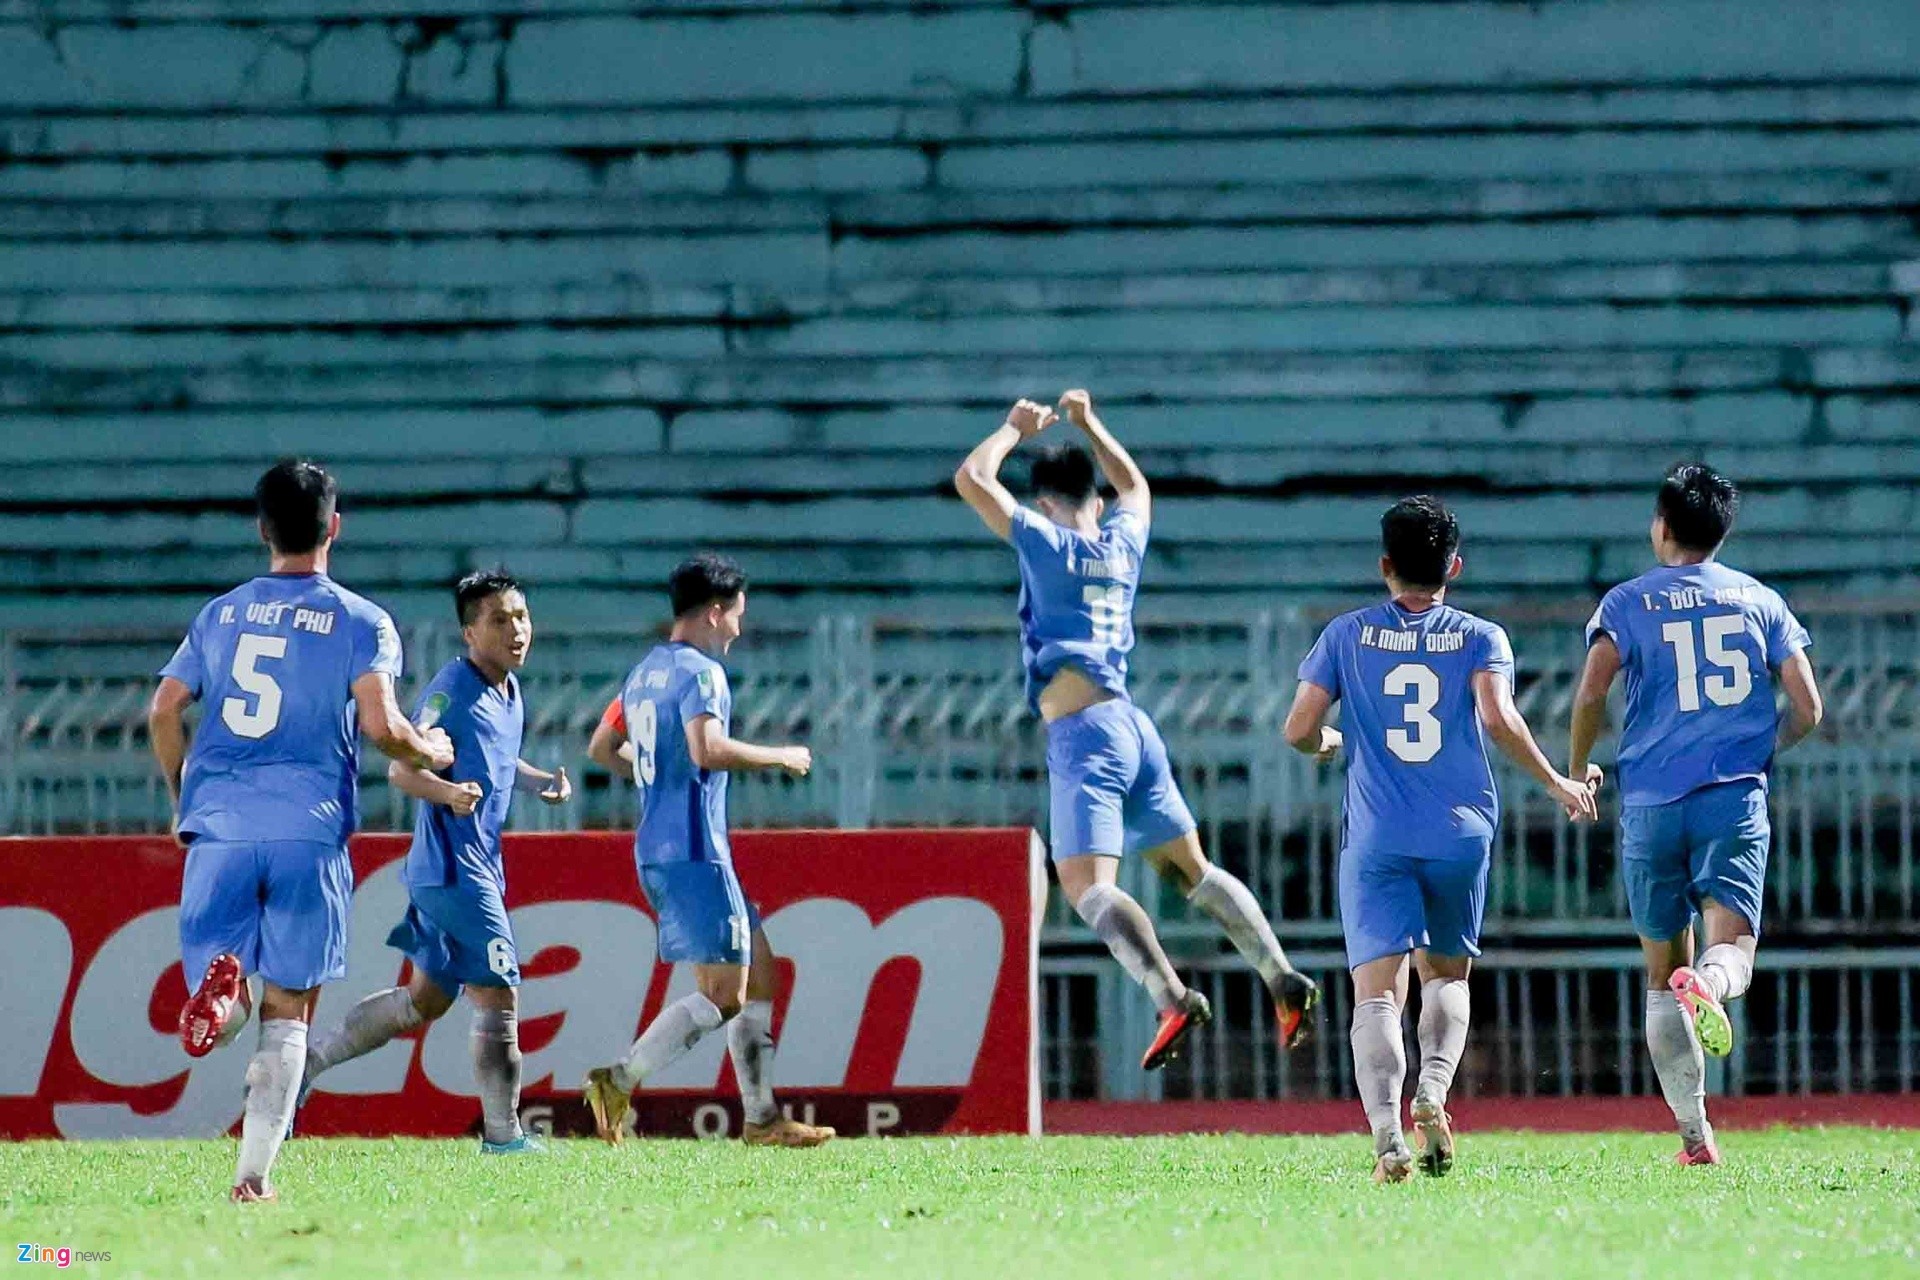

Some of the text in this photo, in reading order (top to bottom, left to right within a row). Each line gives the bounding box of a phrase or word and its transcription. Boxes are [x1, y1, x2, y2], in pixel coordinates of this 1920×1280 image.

[293, 607, 335, 635] PHÚ
[1378, 628, 1418, 652] MINH
[222, 633, 288, 739] 5
[1662, 614, 1752, 712] 15
[1384, 663, 1443, 763] 3
[487, 937, 512, 977] 6
